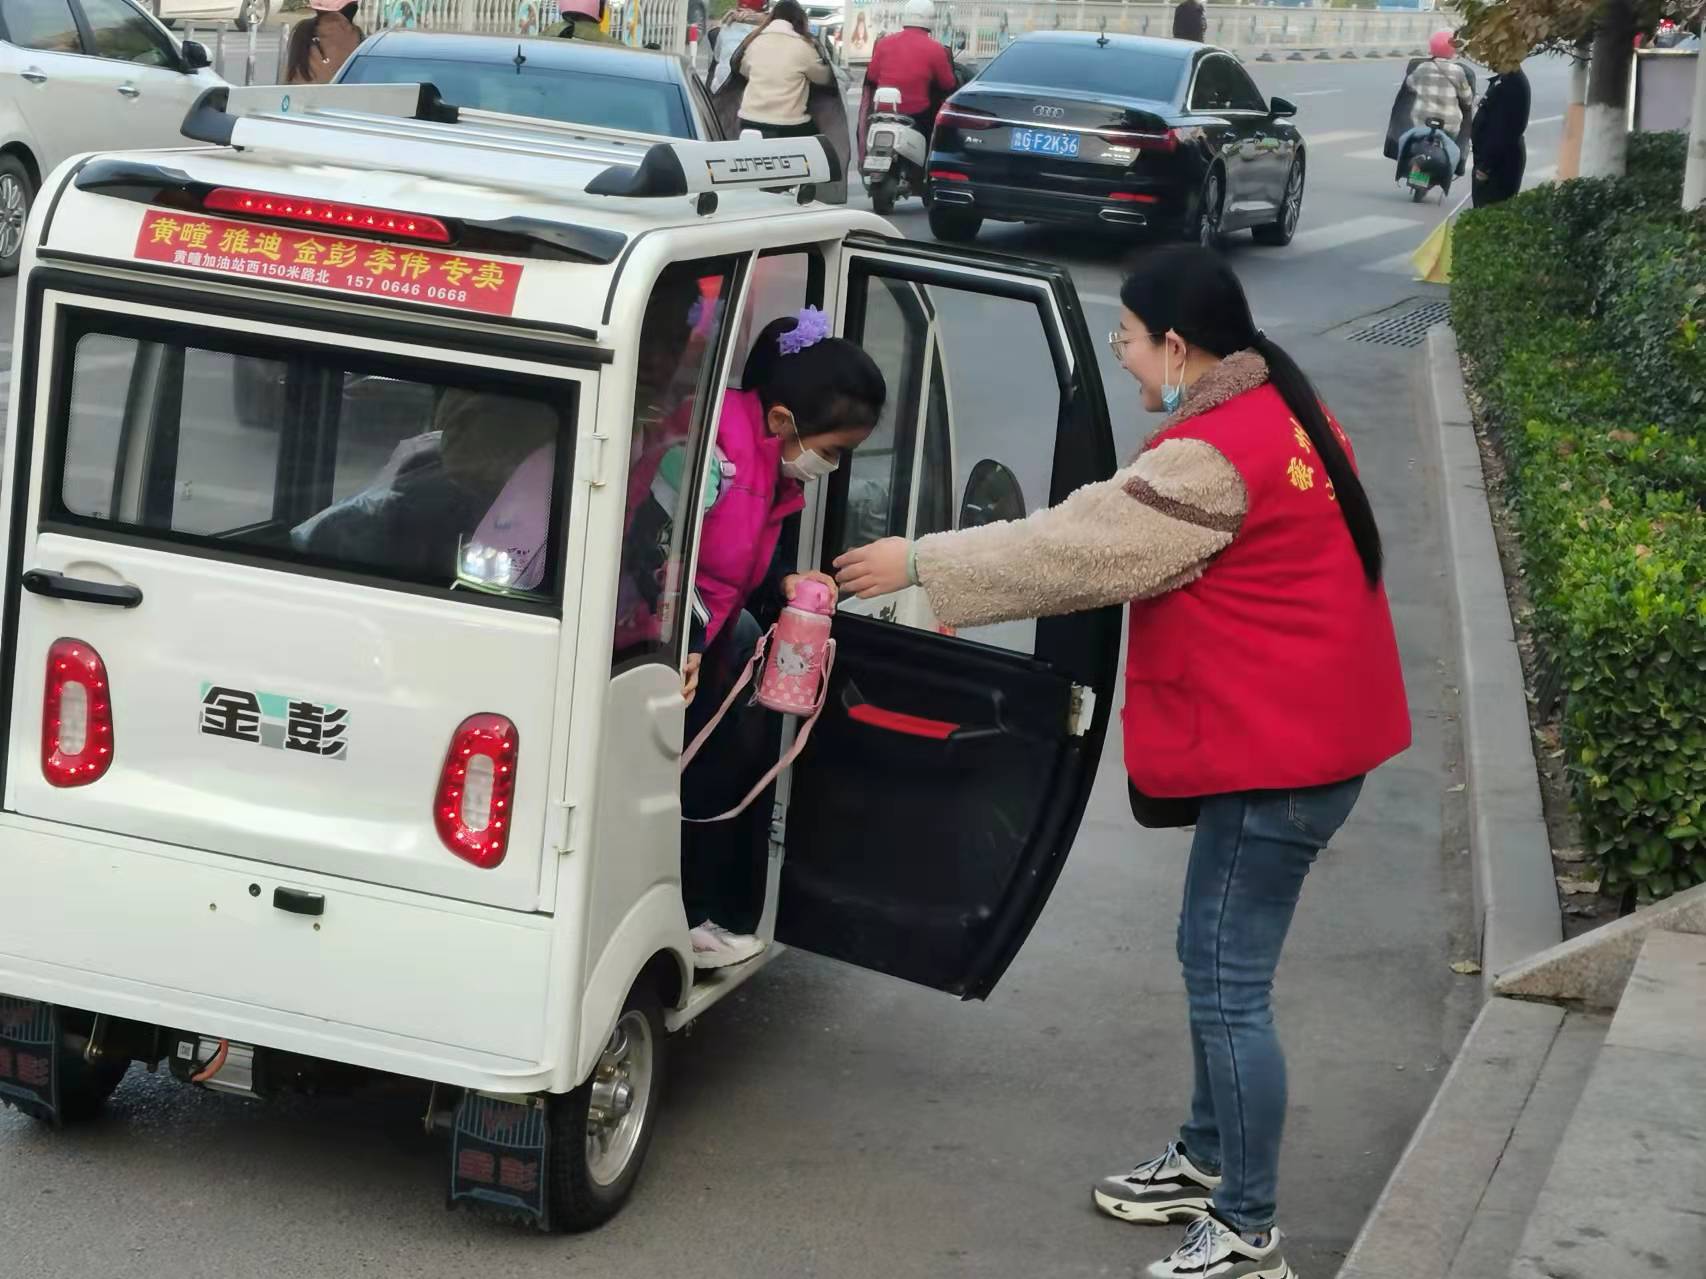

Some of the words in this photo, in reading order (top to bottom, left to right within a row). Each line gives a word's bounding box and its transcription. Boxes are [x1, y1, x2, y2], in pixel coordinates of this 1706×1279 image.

[218, 228, 282, 260] 雅迪
[293, 238, 358, 268] 金彭
[363, 248, 432, 281] 李伟
[440, 258, 504, 292] 专卖
[346, 275, 374, 289] 157
[381, 280, 421, 296] 0646
[428, 286, 467, 303] 0668
[201, 686, 349, 755] 金彭
